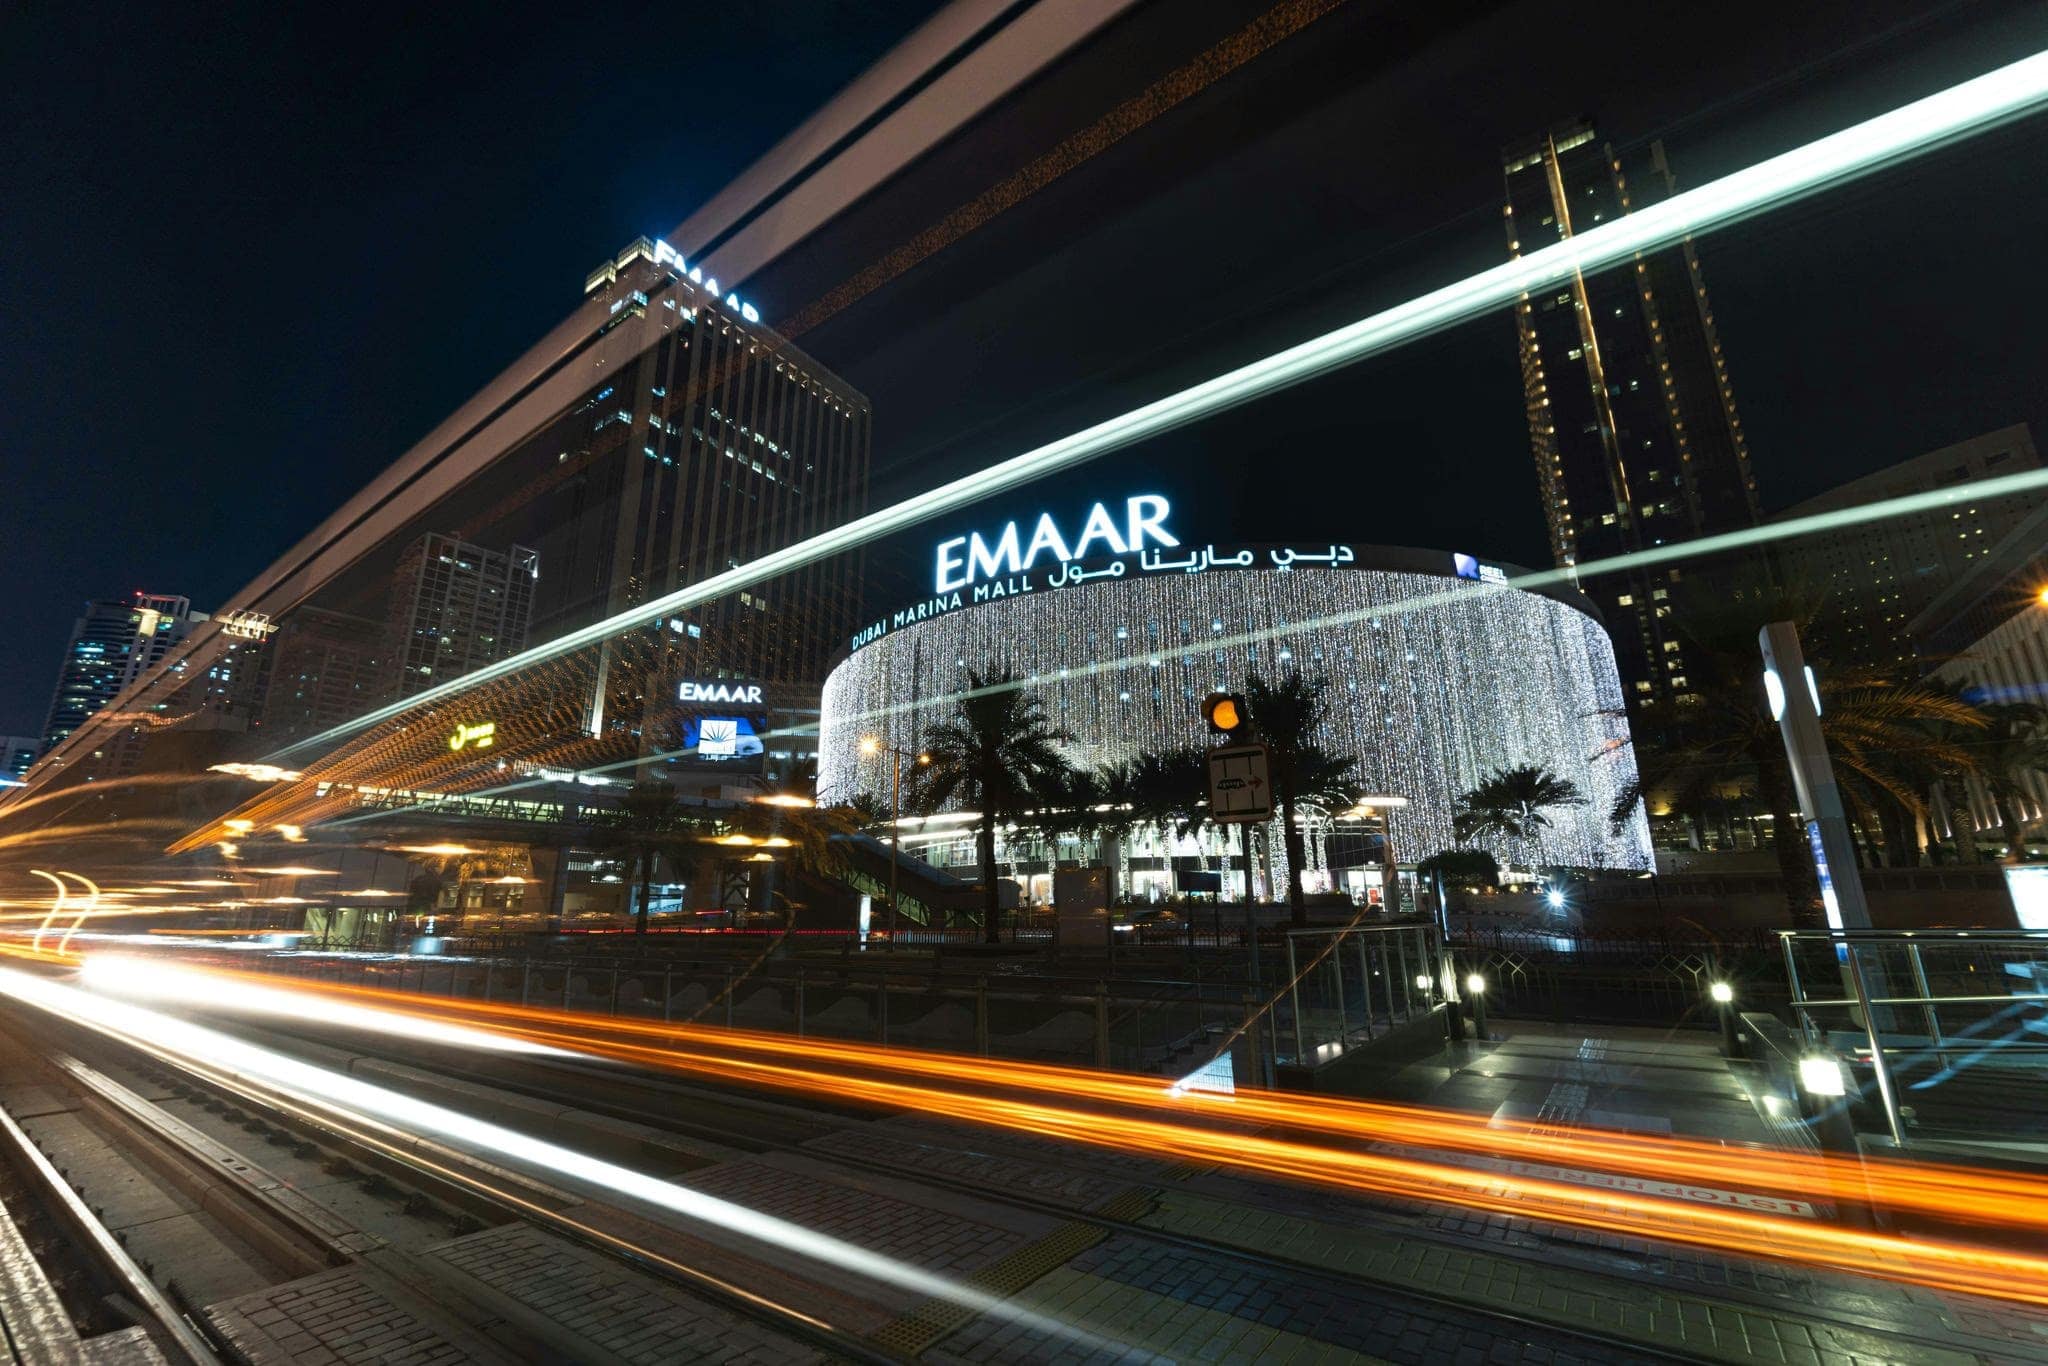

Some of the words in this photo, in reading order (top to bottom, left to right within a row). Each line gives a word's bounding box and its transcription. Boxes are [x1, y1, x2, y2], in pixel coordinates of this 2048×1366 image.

[936, 494, 1180, 594] EMAAR
[1140, 544, 1254, 573] مارينا
[1270, 545, 1355, 572] دبي
[1048, 561, 1125, 588] مول
[852, 618, 887, 650] DUBAI
[894, 592, 962, 629] MARINA
[974, 576, 1033, 602] MALL
[679, 682, 762, 703] EMAAR
[1660, 1187, 1778, 1212] STOP
